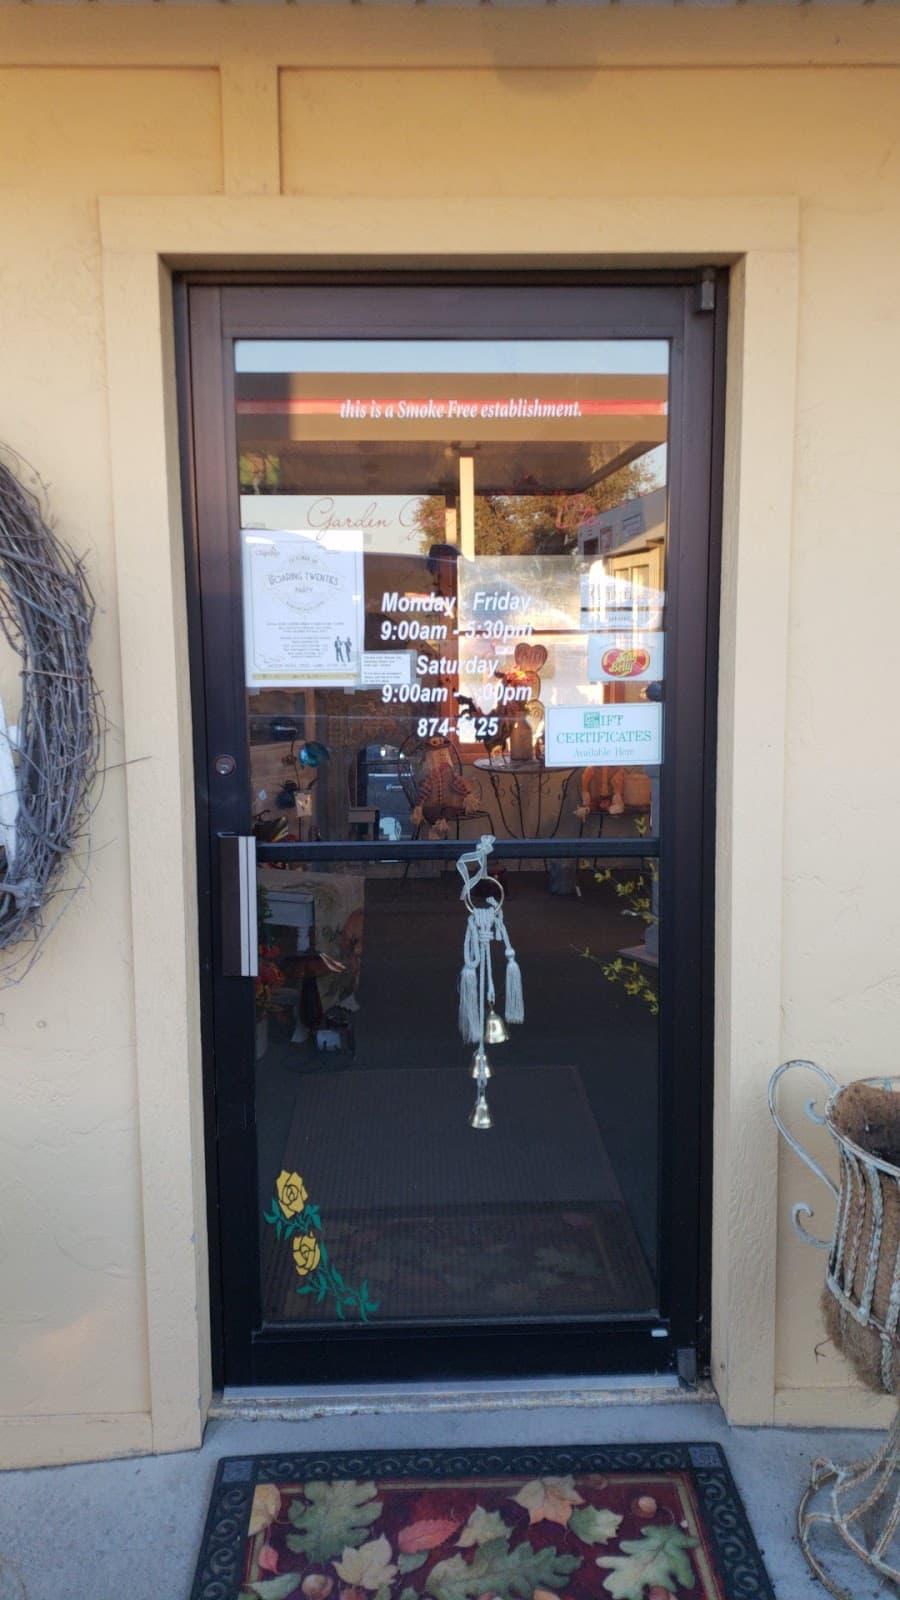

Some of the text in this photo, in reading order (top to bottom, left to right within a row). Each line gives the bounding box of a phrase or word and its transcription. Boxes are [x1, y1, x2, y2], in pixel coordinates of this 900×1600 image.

[340, 398, 582, 418] this is a Smoke Free establishment.
[306, 496, 392, 541] Garden
[381, 592, 456, 617] Monday
[473, 592, 532, 614] Friday
[380, 620, 448, 641] 9:00am
[464, 619, 533, 644] 5:30pm
[416, 655, 500, 678] Saturday
[381, 684, 448, 703] 9:00am
[555, 730, 653, 744] CERTIFICATES
[615, 746, 635, 757] Here
